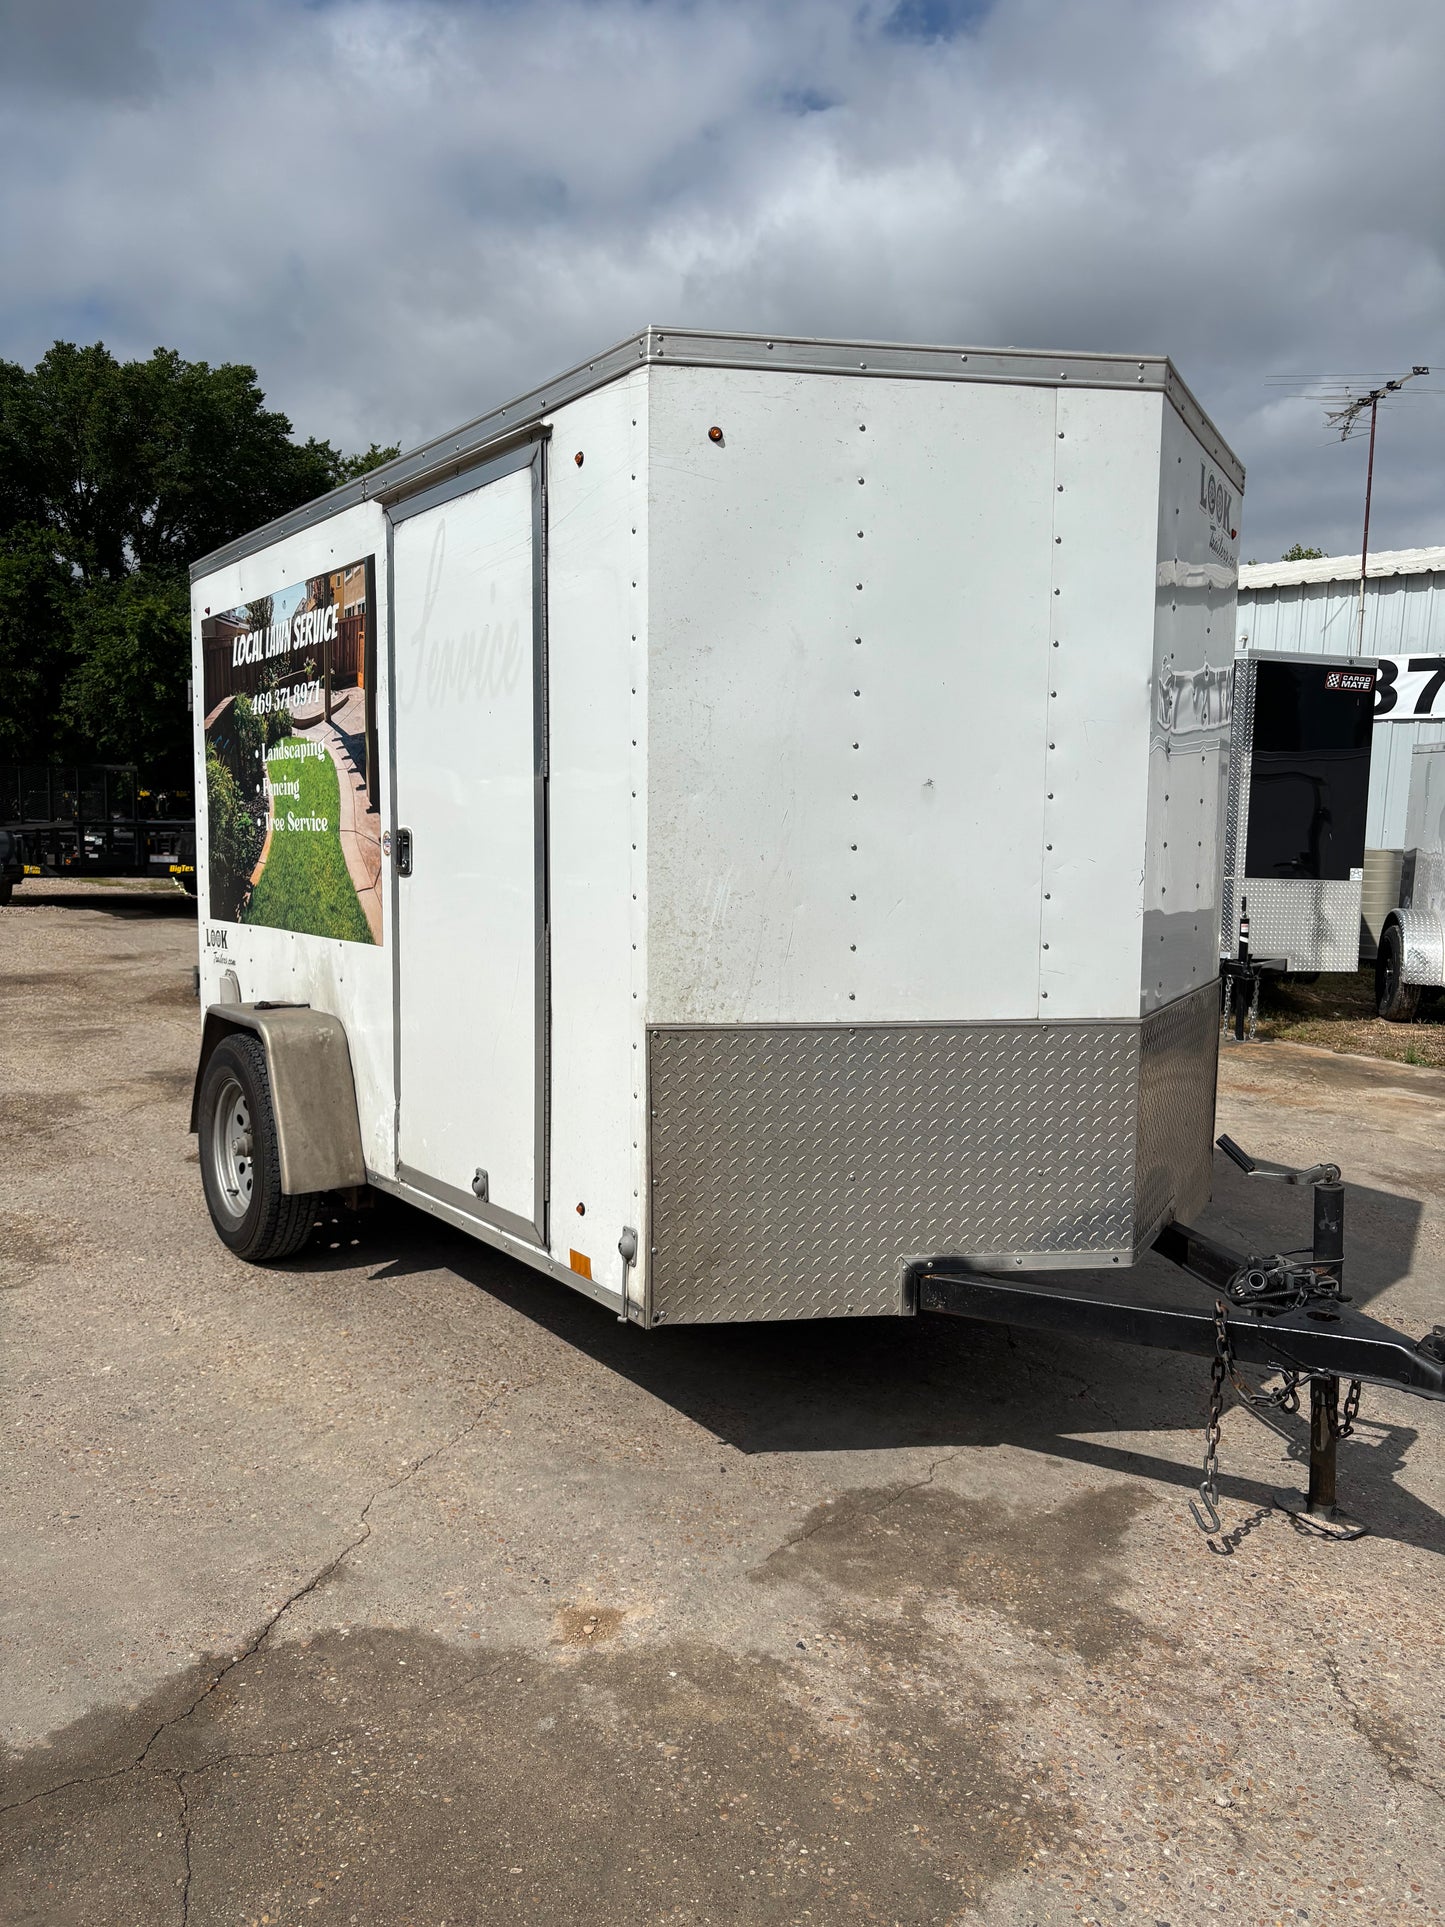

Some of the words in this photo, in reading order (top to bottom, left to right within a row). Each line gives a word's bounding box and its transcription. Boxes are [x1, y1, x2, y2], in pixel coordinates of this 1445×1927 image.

[1199, 460, 1232, 537] LOOK
[232, 629, 264, 668] LOCAL
[265, 617, 292, 659] LAWN
[292, 603, 340, 650] SERVICE
[1341, 680, 1370, 689] MATE
[1342, 675, 1371, 683] CARGO
[250, 679, 320, 716] 469-371-8971
[261, 736, 325, 763] Landscaping
[262, 774, 300, 802] Fencing
[263, 812, 285, 832] Tree
[287, 810, 329, 832] Service
[206, 928, 228, 949] LOOK
